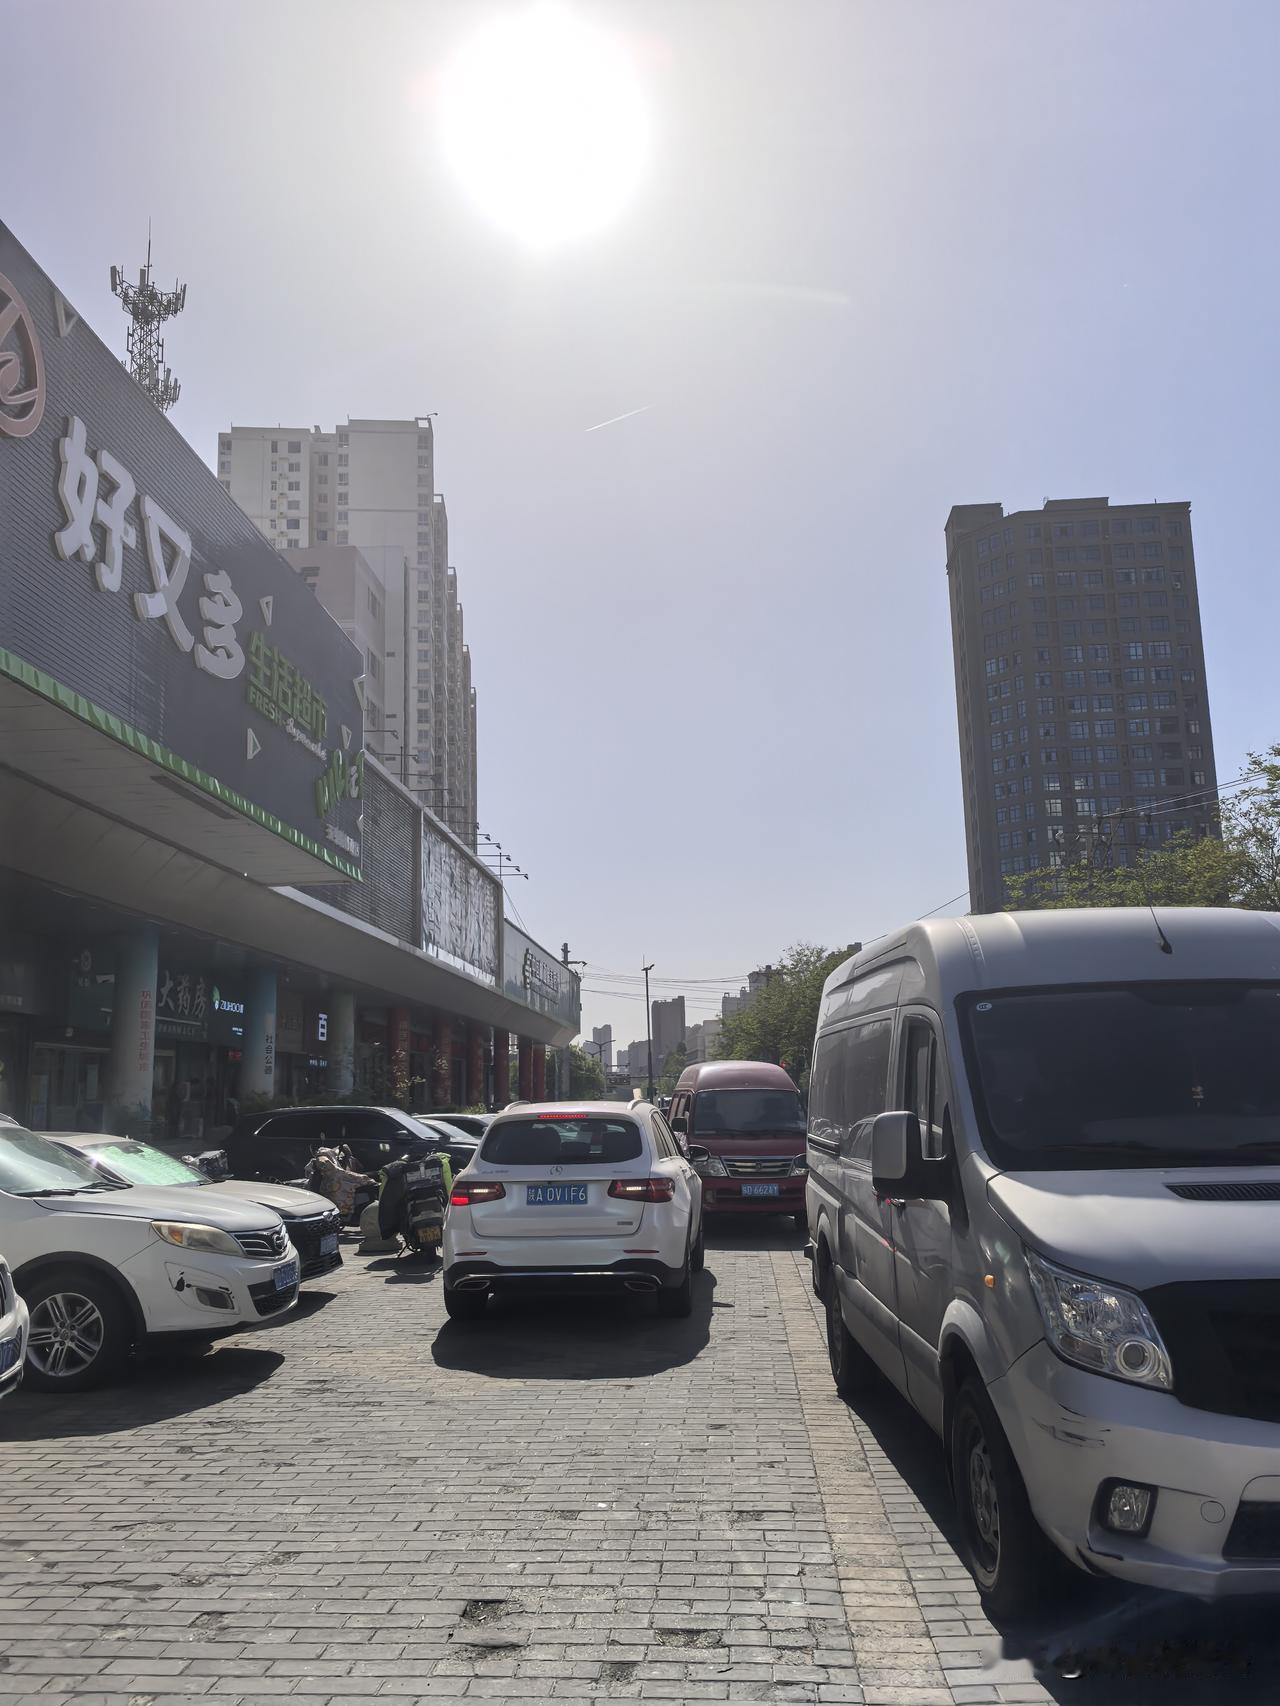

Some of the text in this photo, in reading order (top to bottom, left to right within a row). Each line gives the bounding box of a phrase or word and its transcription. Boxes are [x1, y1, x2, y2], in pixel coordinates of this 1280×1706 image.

[54, 415, 246, 680] 好又多
[249, 631, 327, 741] 生活超市
[249, 686, 283, 727] FRESH
[158, 968, 208, 1018] 大药房
